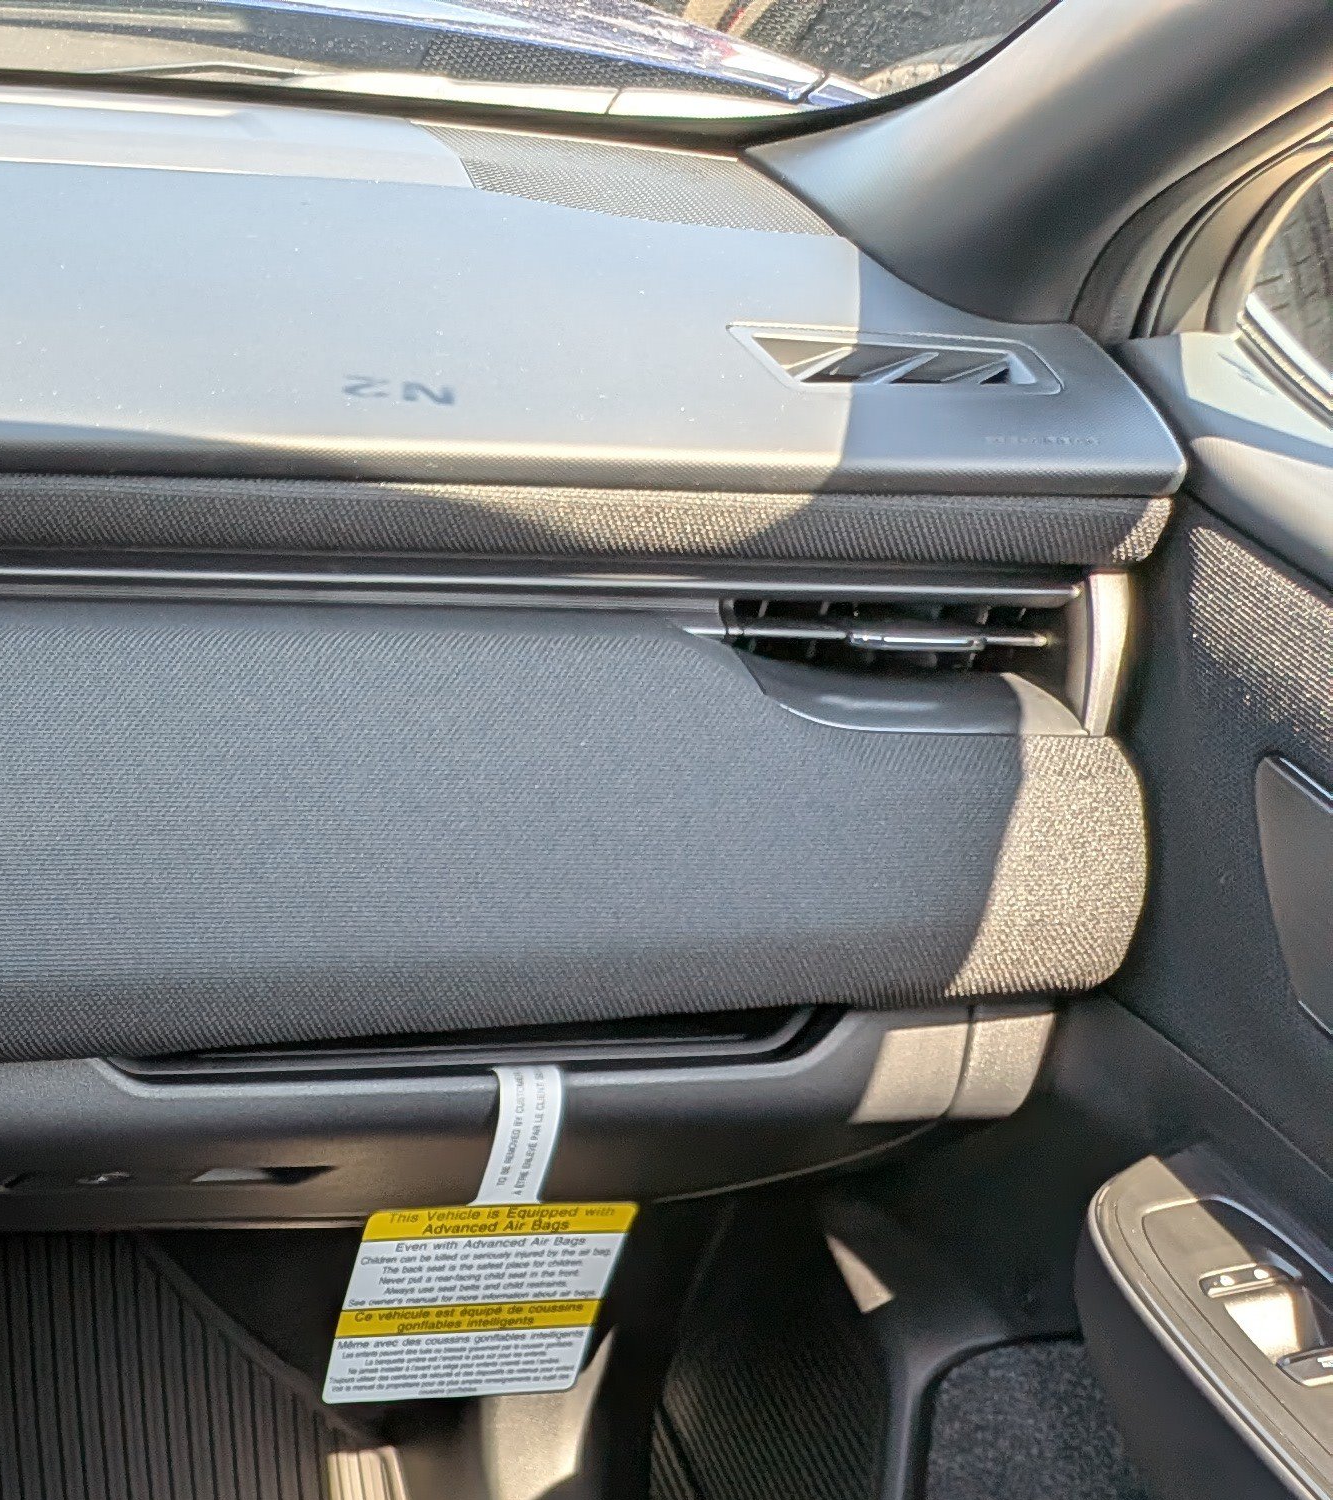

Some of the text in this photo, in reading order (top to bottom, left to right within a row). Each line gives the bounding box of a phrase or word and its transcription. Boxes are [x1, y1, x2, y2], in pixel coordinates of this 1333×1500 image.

[390, 1206, 616, 1224] This Vehicle is Equipped with
[422, 1219, 571, 1236] Advanced Air Bags
[395, 1236, 587, 1253] Even with Advanced Air Bags
[354, 1311, 373, 1323] Ce
[435, 1308, 456, 1318] est
[506, 1305, 524, 1315] de
[528, 1304, 584, 1314] coussins
[466, 1316, 535, 1328] intelligents
